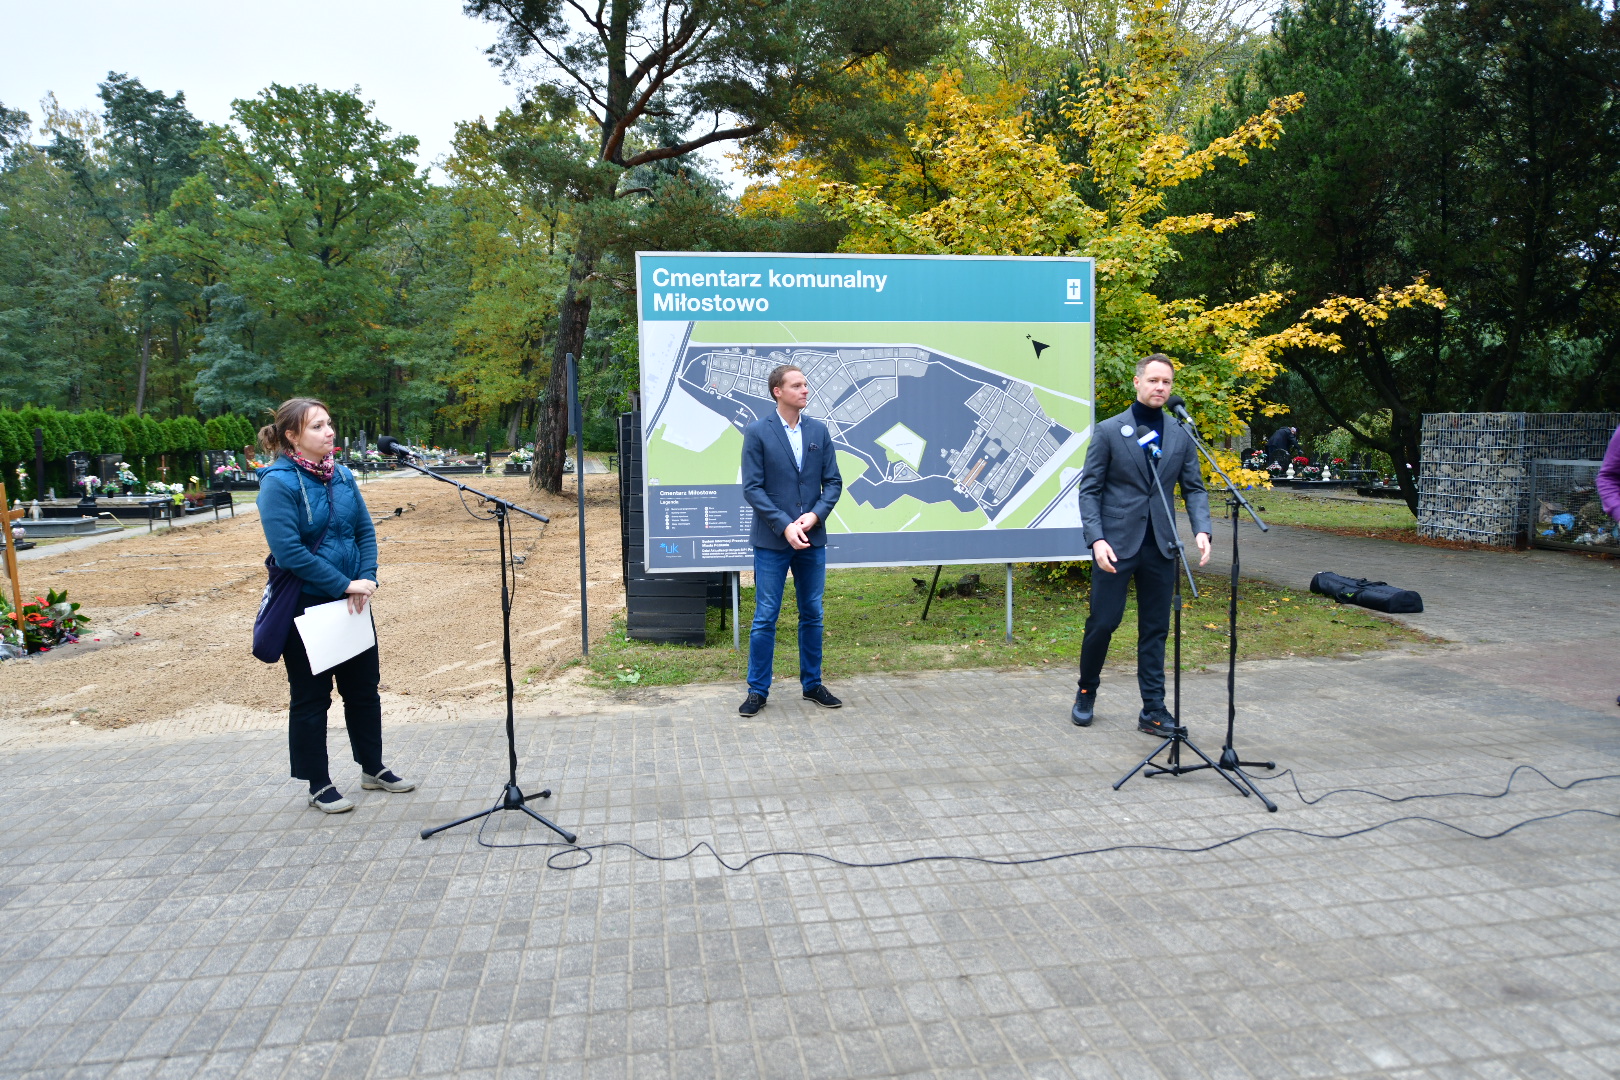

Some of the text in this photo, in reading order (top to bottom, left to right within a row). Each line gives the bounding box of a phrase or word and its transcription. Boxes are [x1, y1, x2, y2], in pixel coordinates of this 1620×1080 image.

[652, 267, 888, 293] Cmentarz komunalny
[653, 292, 769, 312] Miłostowo
